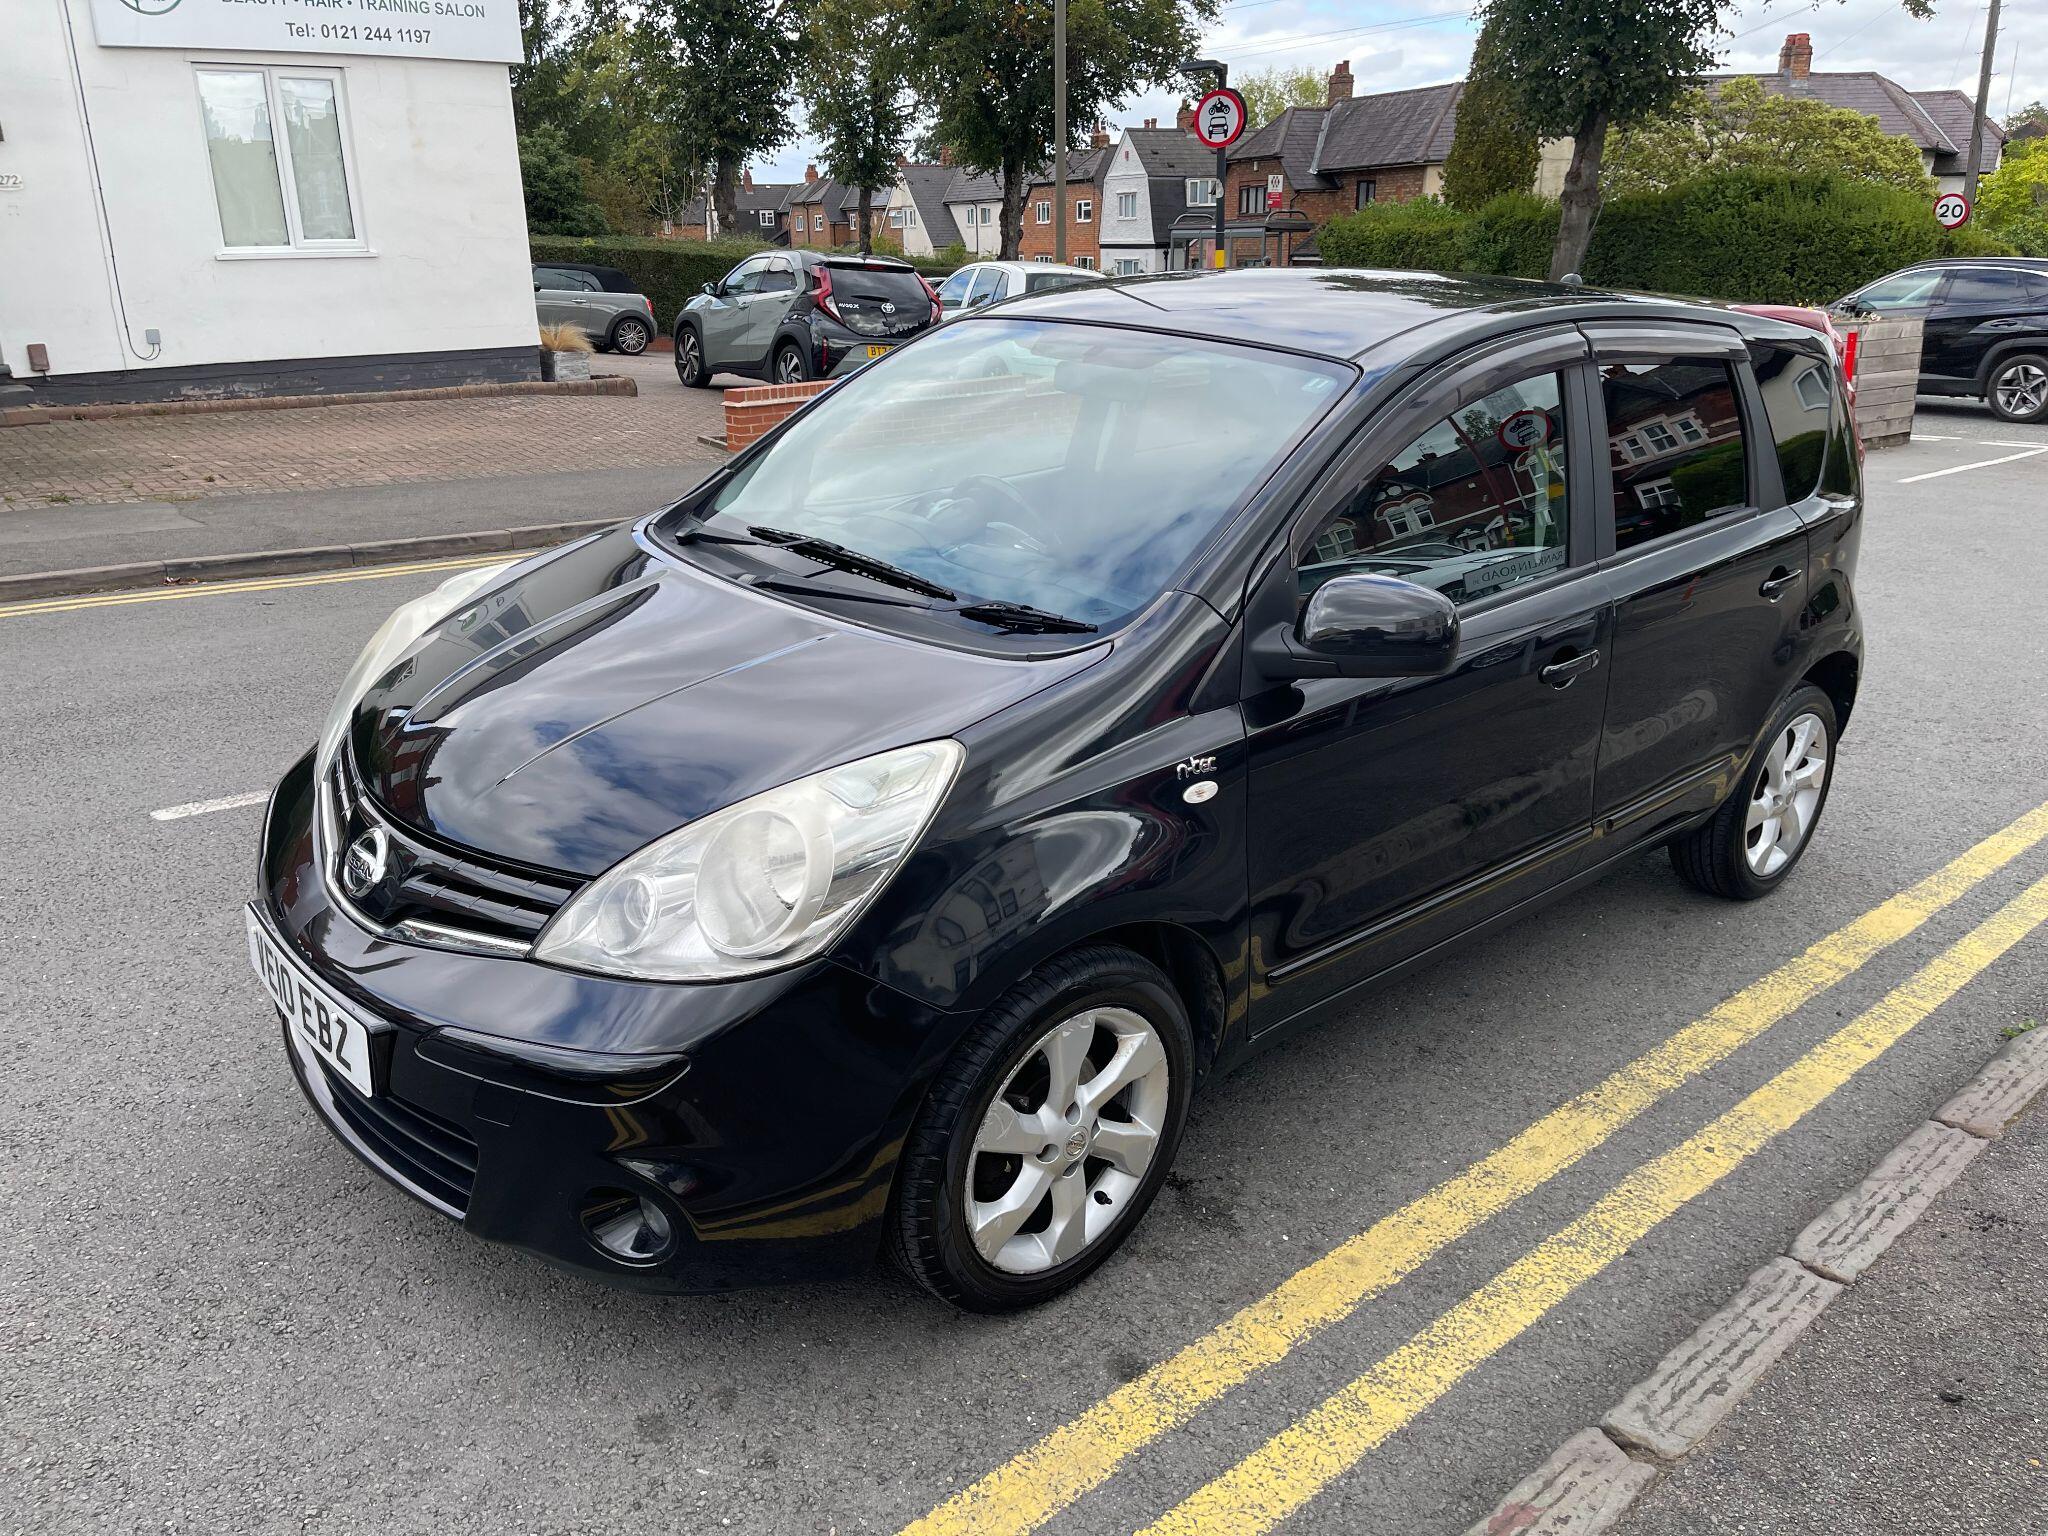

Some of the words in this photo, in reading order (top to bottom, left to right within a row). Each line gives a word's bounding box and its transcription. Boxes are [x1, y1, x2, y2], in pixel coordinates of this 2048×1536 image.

[358, 0, 430, 14] TRAINING
[434, 2, 485, 18] SALON
[285, 22, 315, 38] Tel:
[321, 24, 358, 40] 0121
[364, 26, 392, 42] 244
[397, 28, 431, 44] 1197
[1938, 203, 1964, 219] 20
[298, 981, 352, 1073] EBZ
